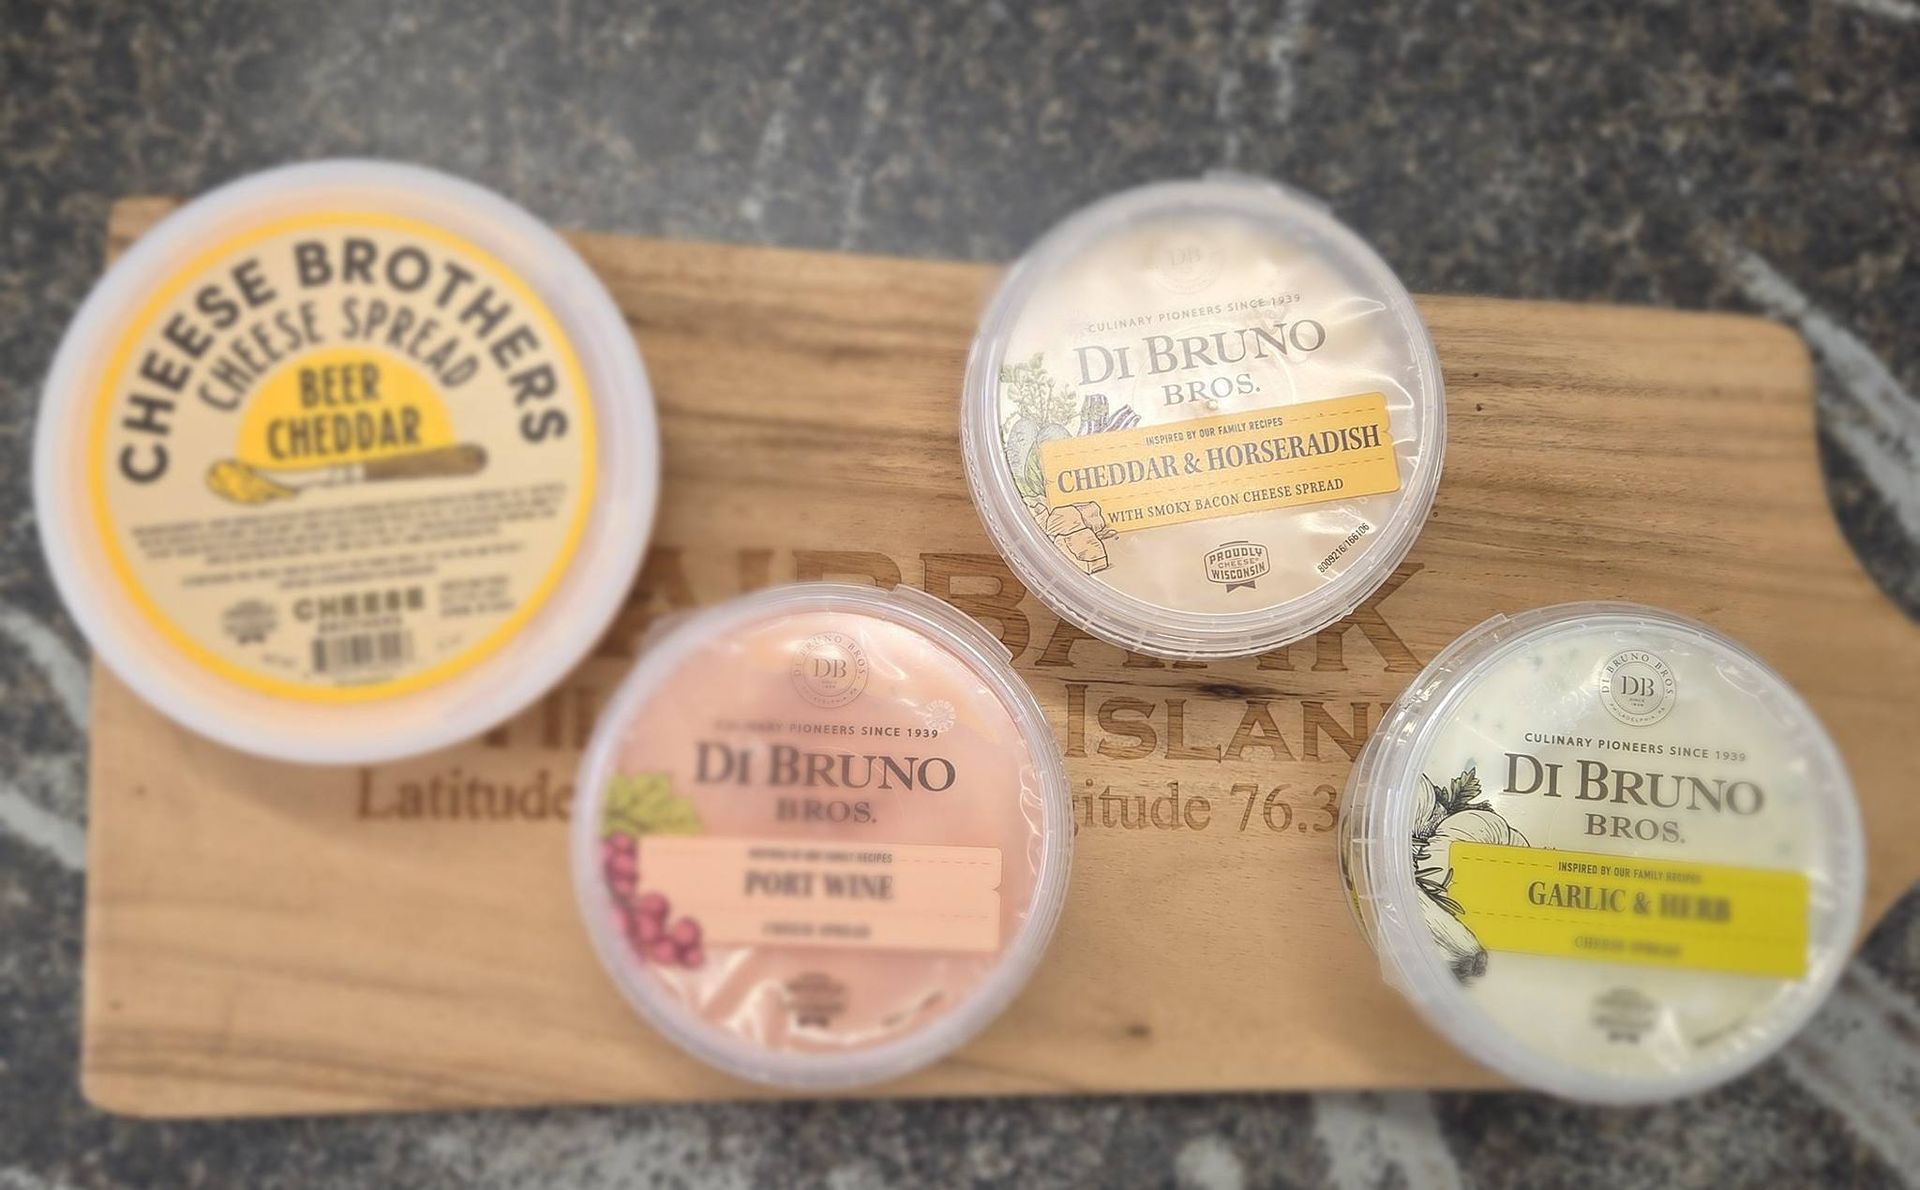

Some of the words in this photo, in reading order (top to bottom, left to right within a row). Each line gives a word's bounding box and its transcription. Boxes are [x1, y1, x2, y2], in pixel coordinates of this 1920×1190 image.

[1088, 316, 1152, 333] CULINARY
[1159, 305, 1222, 322] PIONEERS
[1227, 298, 1266, 312] SINCE
[1271, 293, 1301, 307] 1939
[119, 259, 278, 484] CHEESE
[294, 237, 568, 444] BROTHERS
[199, 301, 326, 411] CHEESE
[340, 297, 479, 389] SPREAD
[1142, 319, 1326, 375] BRUNO
[298, 362, 380, 409] BEER
[1161, 373, 1261, 406] BROS.
[266, 407, 421, 460] CHEDDAR
[1146, 431, 1183, 446] INSPIRED
[1187, 430, 1197, 439] BY
[1199, 427, 1215, 437] OUR
[1218, 422, 1247, 435] FAMILY
[1250, 417, 1283, 430] RECIPES
[1056, 455, 1178, 494] CHEDDAR
[1183, 452, 1202, 474] &
[1205, 424, 1382, 471] HORSERADISH
[1107, 508, 1144, 524] WITH
[1148, 501, 1192, 519] SMOKY
[1195, 495, 1239, 511] BACON
[1242, 487, 1292, 503] CHEESE
[1295, 478, 1344, 497] SPREAD
[1209, 547, 1262, 565] PROUDLY
[1211, 562, 1266, 580] WISCONSIN
[813, 659, 846, 678] DB
[1606, 653, 1649, 673] BRUNO
[1621, 676, 1654, 696] DB
[789, 723, 855, 735] PIONEERS
[861, 727, 900, 737] SINCE
[907, 728, 938, 739] 1939
[1064, 683, 1393, 763] ISLAN
[1524, 733, 1592, 748] CULINARY
[1599, 739, 1664, 755] PIONEERS
[1669, 746, 1709, 759] SINCE
[1715, 751, 1746, 762] 1939
[768, 745, 956, 792] BRUNO
[1575, 759, 1765, 816] BRUNO
[776, 799, 877, 824] BROS.
[1073, 779, 1210, 836] itude
[1584, 813, 1685, 843] BROS.
[1558, 862, 1597, 874] INSPIRED
[1600, 865, 1611, 876] BY
[1614, 866, 1631, 878] OUR
[1634, 869, 1664, 881] FAMILY
[1528, 881, 1625, 912] GARLIC
[1632, 892, 1650, 915] &
